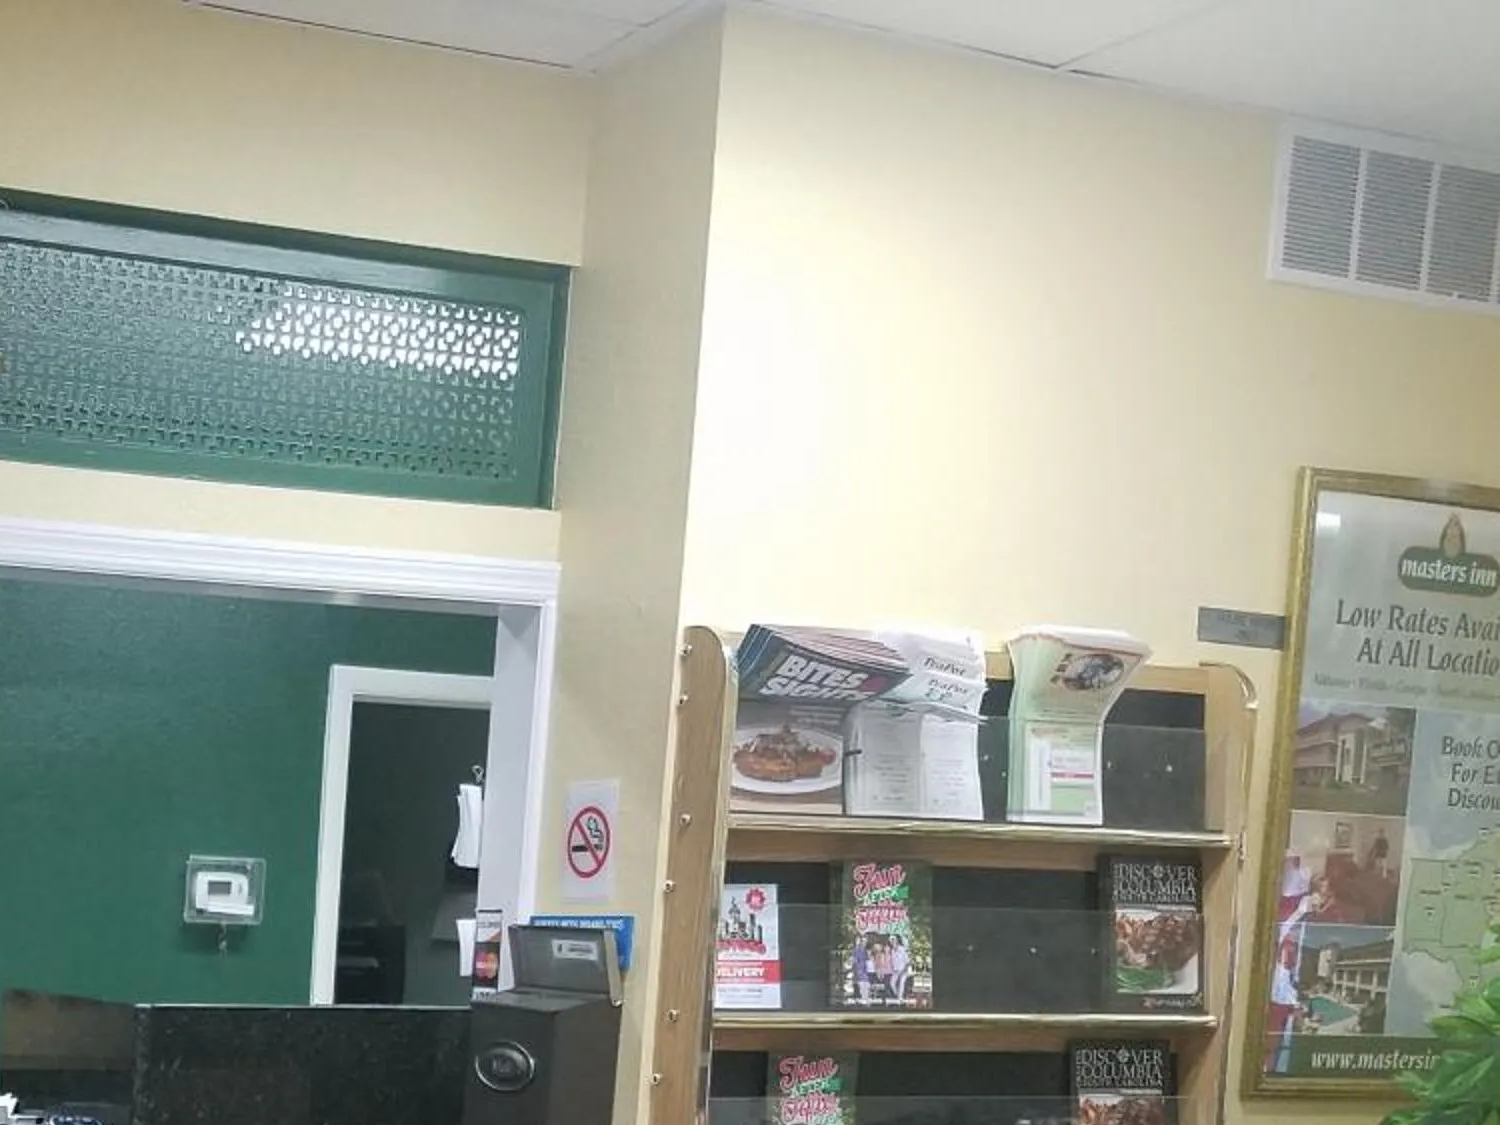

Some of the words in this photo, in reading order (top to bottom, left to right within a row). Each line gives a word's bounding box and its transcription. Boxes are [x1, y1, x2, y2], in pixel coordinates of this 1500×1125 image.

[1401, 558, 1467, 584] masters
[1469, 561, 1497, 587] inn
[1336, 599, 1382, 628] Low
[1387, 604, 1448, 636] Rates
[1356, 637, 1382, 665] At
[1389, 638, 1421, 672] All
[776, 655, 868, 690] BITES
[1442, 735, 1483, 758] Book
[1487, 740, 1500, 759] O
[1451, 762, 1479, 783] For
[1484, 765, 1500, 786] E
[1080, 1047, 1163, 1065] DISCOVER
[1081, 1064, 1164, 1079] COLUMBIA
